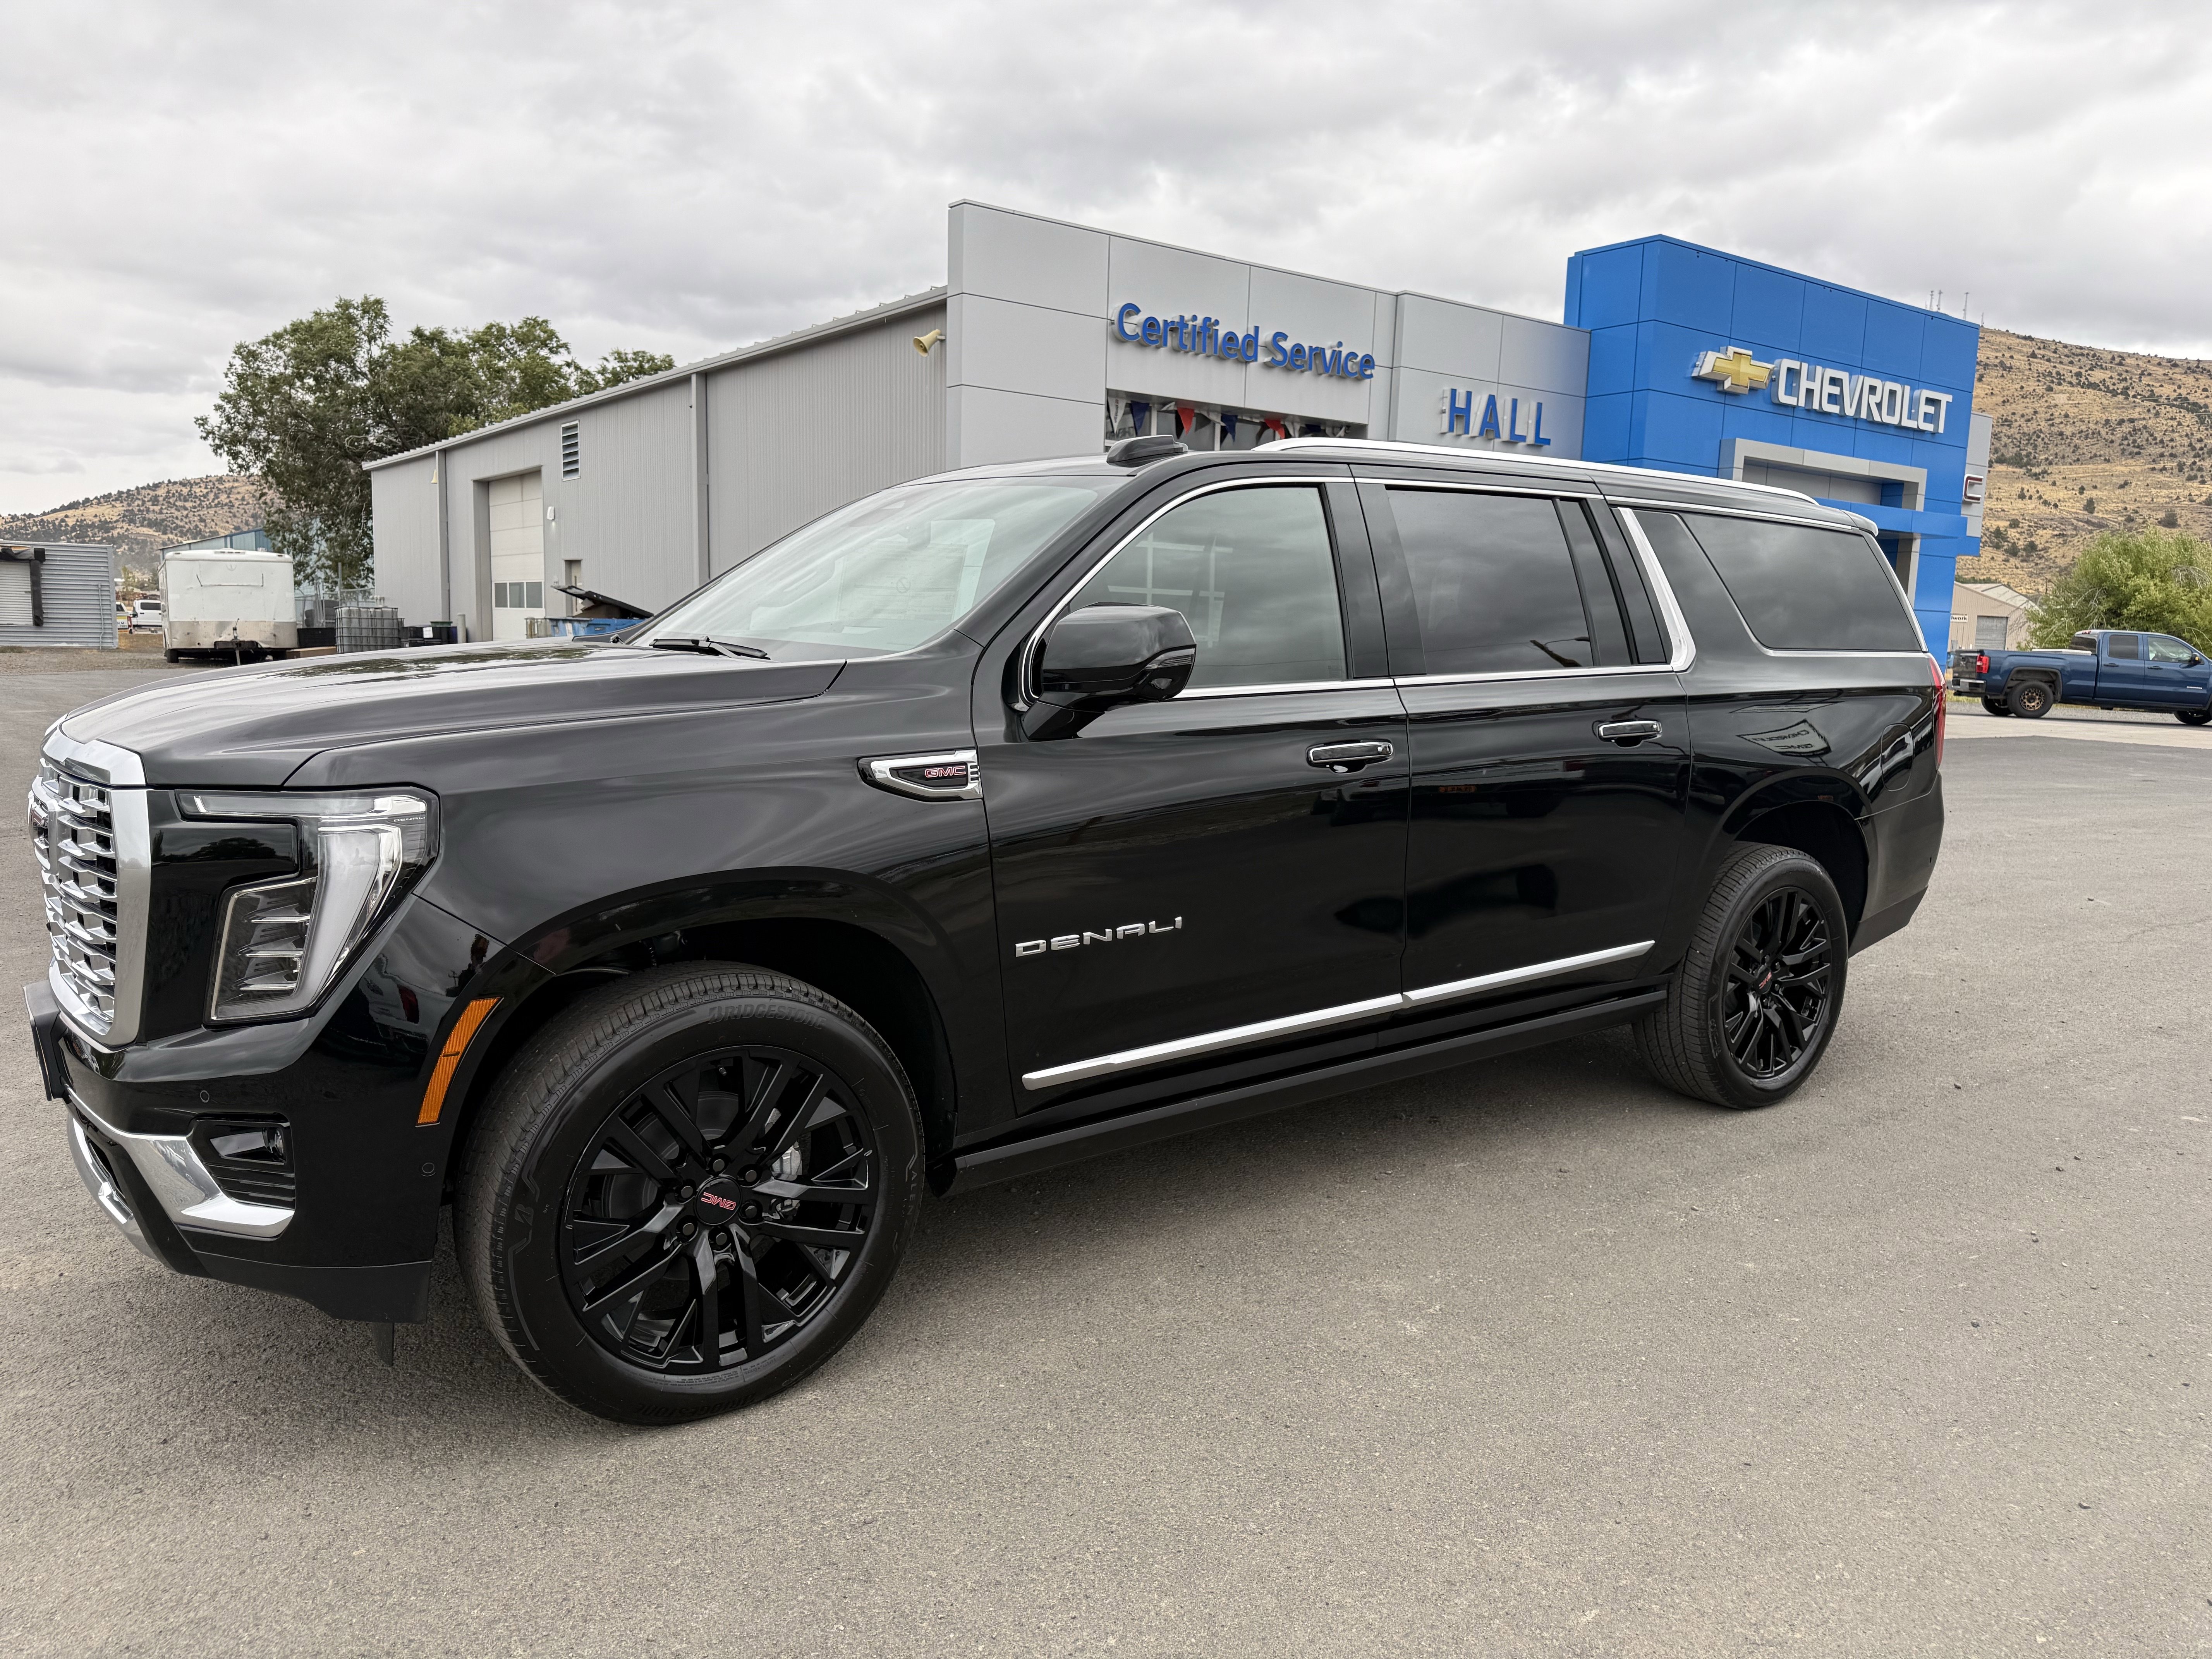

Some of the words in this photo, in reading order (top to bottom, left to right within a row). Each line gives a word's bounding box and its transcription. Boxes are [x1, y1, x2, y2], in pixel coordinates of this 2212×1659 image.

[1118, 303, 1259, 363] Certified
[1271, 331, 1375, 379] Service
[1448, 388, 1551, 445] HALL
[1777, 358, 1953, 434] CHEVROLET
[925, 766, 966, 778] GMC
[1015, 916, 1182, 957] DENALI
[708, 1004, 826, 1029] BRIDGESTONE
[701, 1192, 737, 1211] GMC
